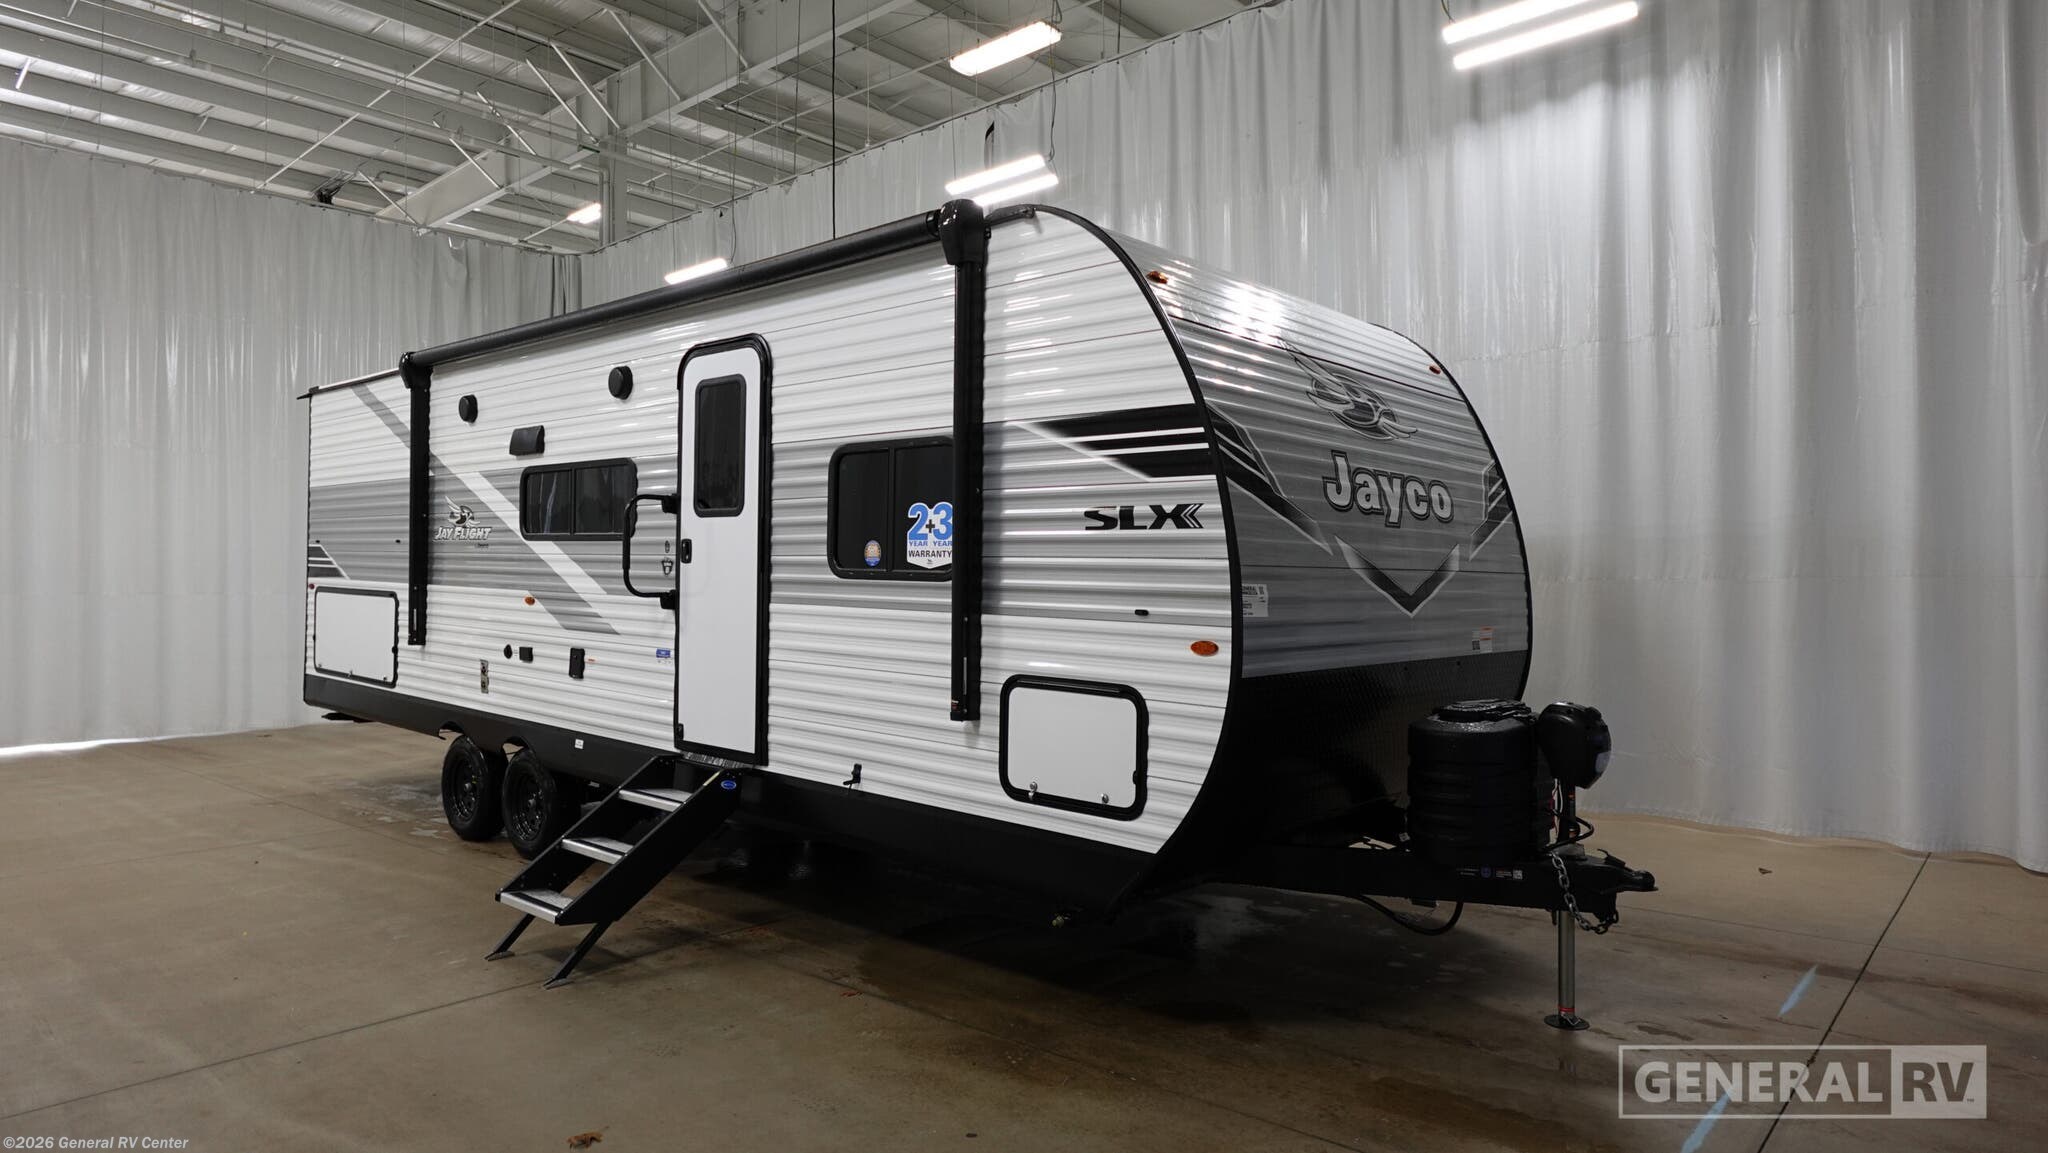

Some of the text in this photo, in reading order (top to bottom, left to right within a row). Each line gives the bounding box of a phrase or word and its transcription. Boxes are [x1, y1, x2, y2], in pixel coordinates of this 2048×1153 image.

[1323, 450, 1454, 527] Jayco
[1084, 503, 1204, 530] SLX
[434, 527, 492, 541] JAY FLIGHT
[908, 550, 952, 558] WARRANTY
